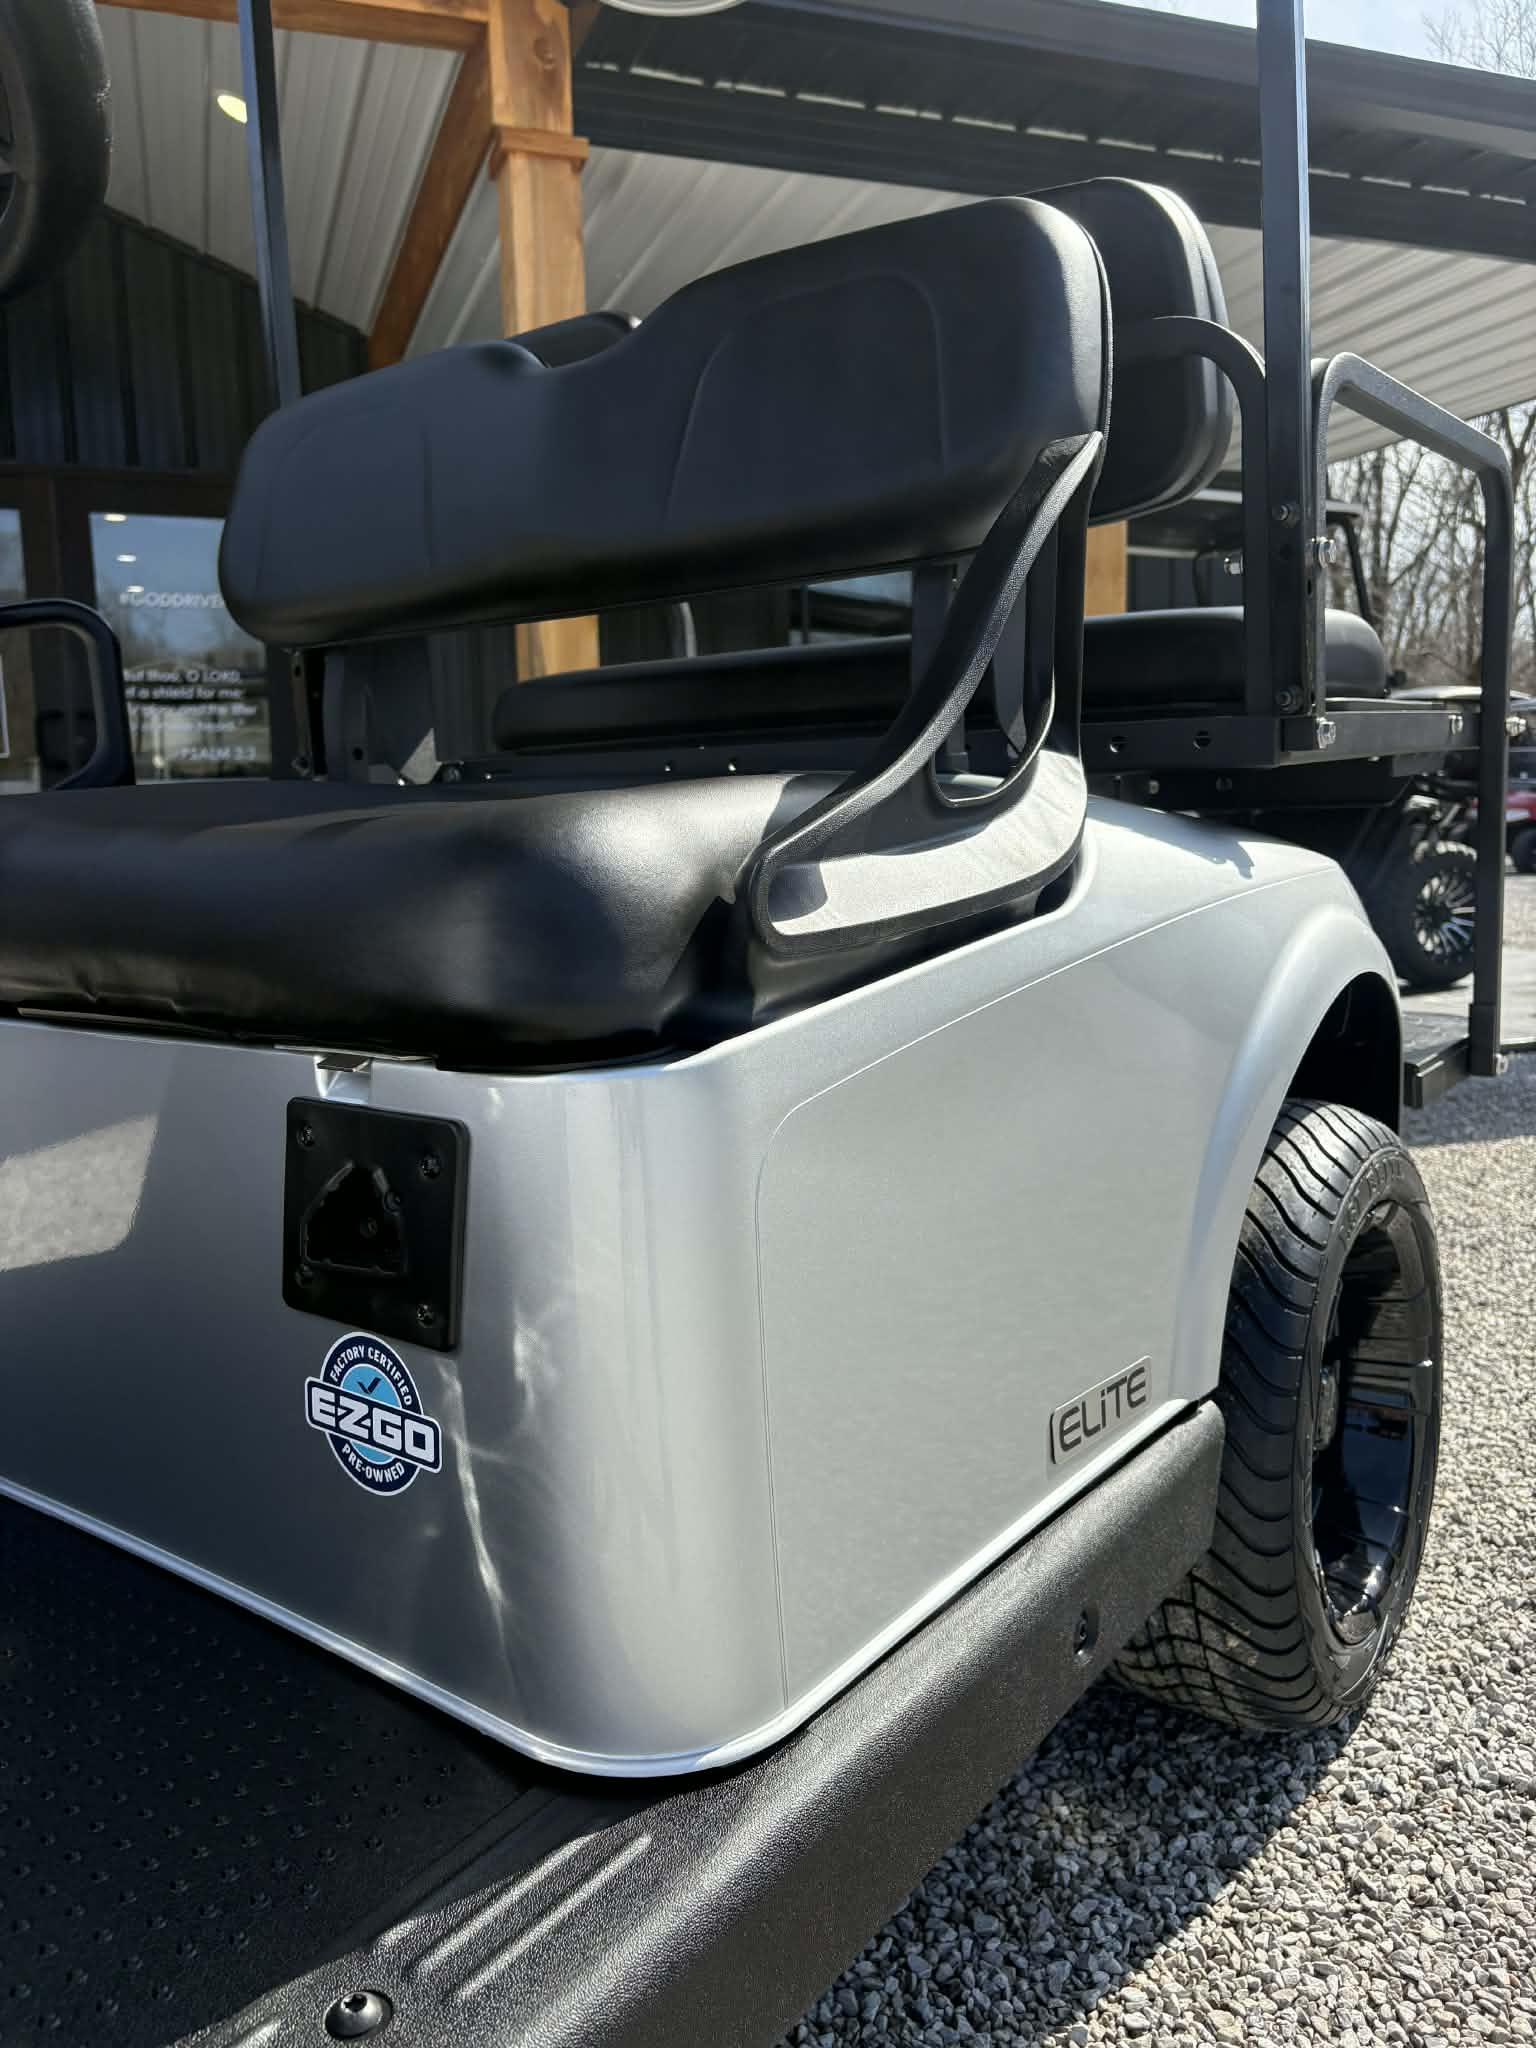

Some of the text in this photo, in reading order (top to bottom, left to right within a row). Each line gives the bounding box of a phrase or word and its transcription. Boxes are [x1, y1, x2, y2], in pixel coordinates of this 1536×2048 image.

[330, 1345, 412, 1406] FACTORY CERTIFIED
[341, 1443, 405, 1483] PRE-OWNED
